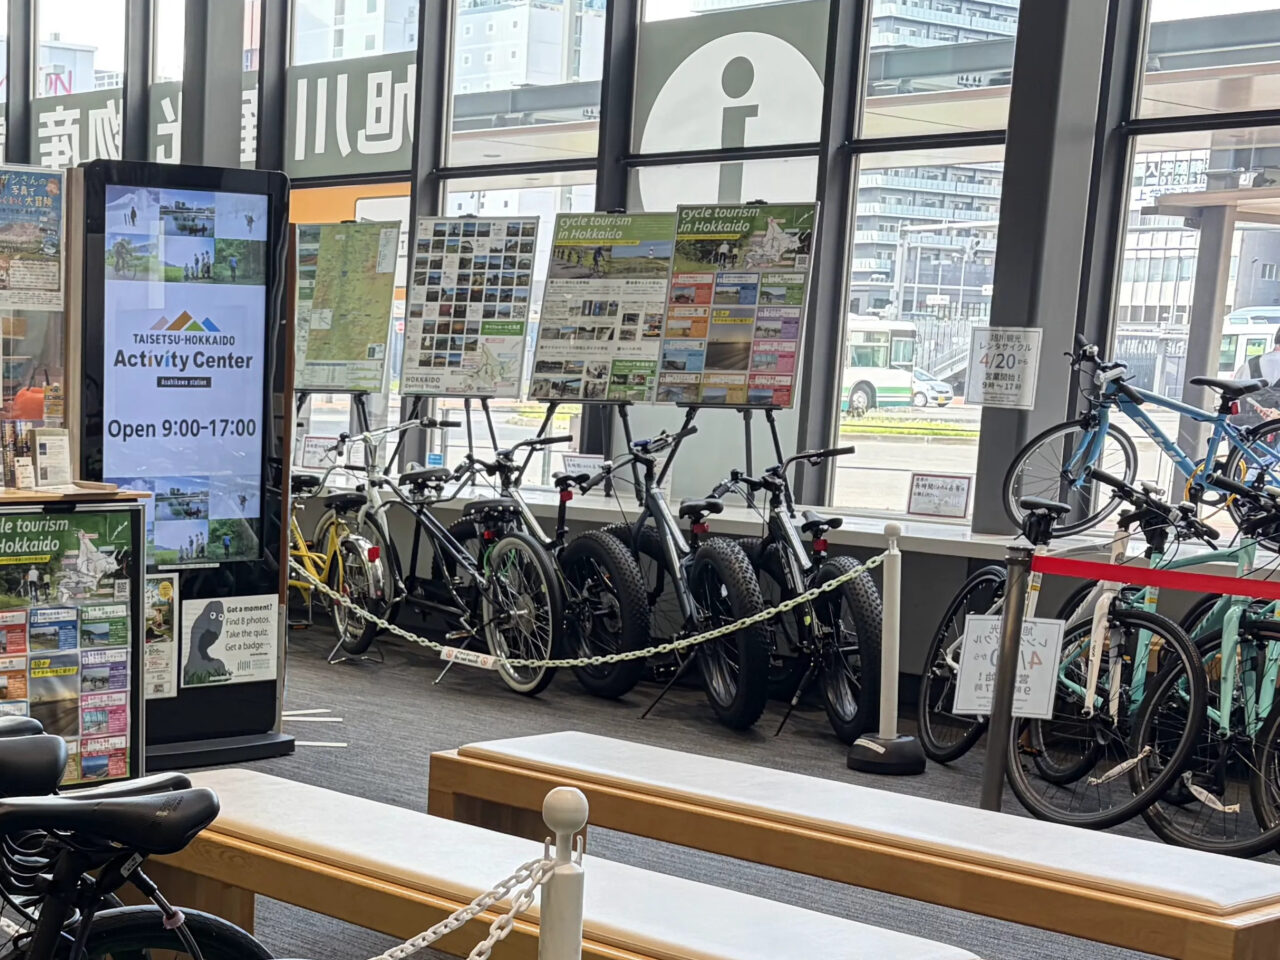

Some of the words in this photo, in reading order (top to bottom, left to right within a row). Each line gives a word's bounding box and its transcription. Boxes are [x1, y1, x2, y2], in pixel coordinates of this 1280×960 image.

[681, 207, 715, 220] cycle
[717, 206, 760, 218] tourism
[560, 215, 590, 228] cycle
[591, 214, 632, 226] tourism
[693, 219, 751, 232] Hokkaido
[558, 229, 568, 239] in
[570, 228, 623, 239] Hokkaido
[133, 333, 236, 346] TAISETSU-HOKKAIDO
[979, 342, 1033, 351] レンタサイクル
[113, 350, 189, 372] Activity
[193, 350, 254, 369] Center
[108, 419, 156, 442] Open
[162, 418, 257, 438] 9:00-17:00
[16, 516, 69, 533] tourism
[243, 604, 273, 612] moment?
[226, 617, 240, 626] Find
[225, 630, 240, 638] Take
[241, 629, 252, 637] the
[225, 643, 236, 652] Get
